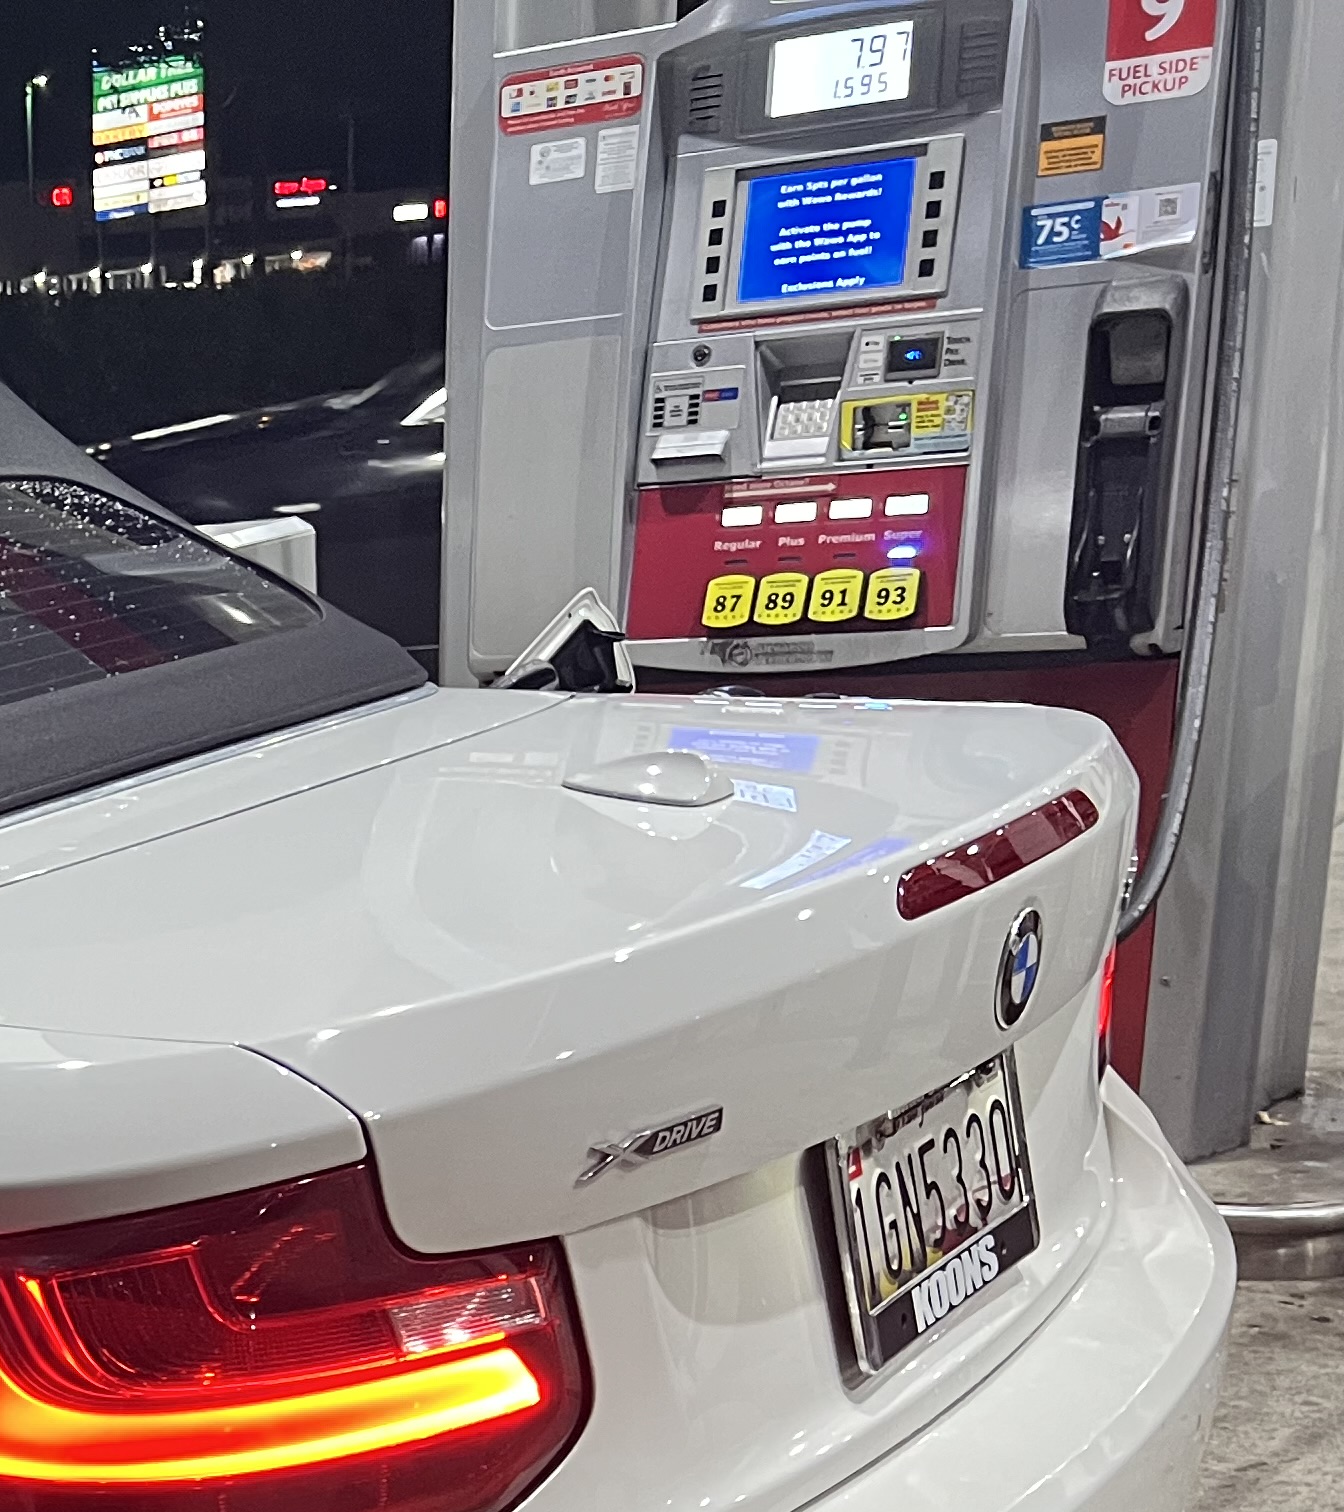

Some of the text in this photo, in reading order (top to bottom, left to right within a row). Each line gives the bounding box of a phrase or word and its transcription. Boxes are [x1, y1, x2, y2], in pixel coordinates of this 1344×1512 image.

[1141, 0, 1185, 42] 9
[100, 66, 158, 91] DOLLAR
[1108, 63, 1152, 83] FUEL
[1120, 75, 1190, 98] PICKUP
[830, 178, 849, 189] per
[777, 199, 800, 208] with
[779, 225, 821, 236] Activate
[822, 222, 840, 231] the
[794, 239, 811, 249] the
[846, 233, 868, 243] App
[869, 231, 881, 240] to
[835, 275, 866, 288] Apply
[713, 529, 923, 553] Regular Plus Premium Super
[713, 594, 743, 614] 87
[765, 591, 796, 611] 89
[820, 588, 849, 608] 91
[876, 586, 907, 606] 93
[852, 1097, 1018, 1302] 1GN5330
[912, 1234, 1000, 1334] KOONS
